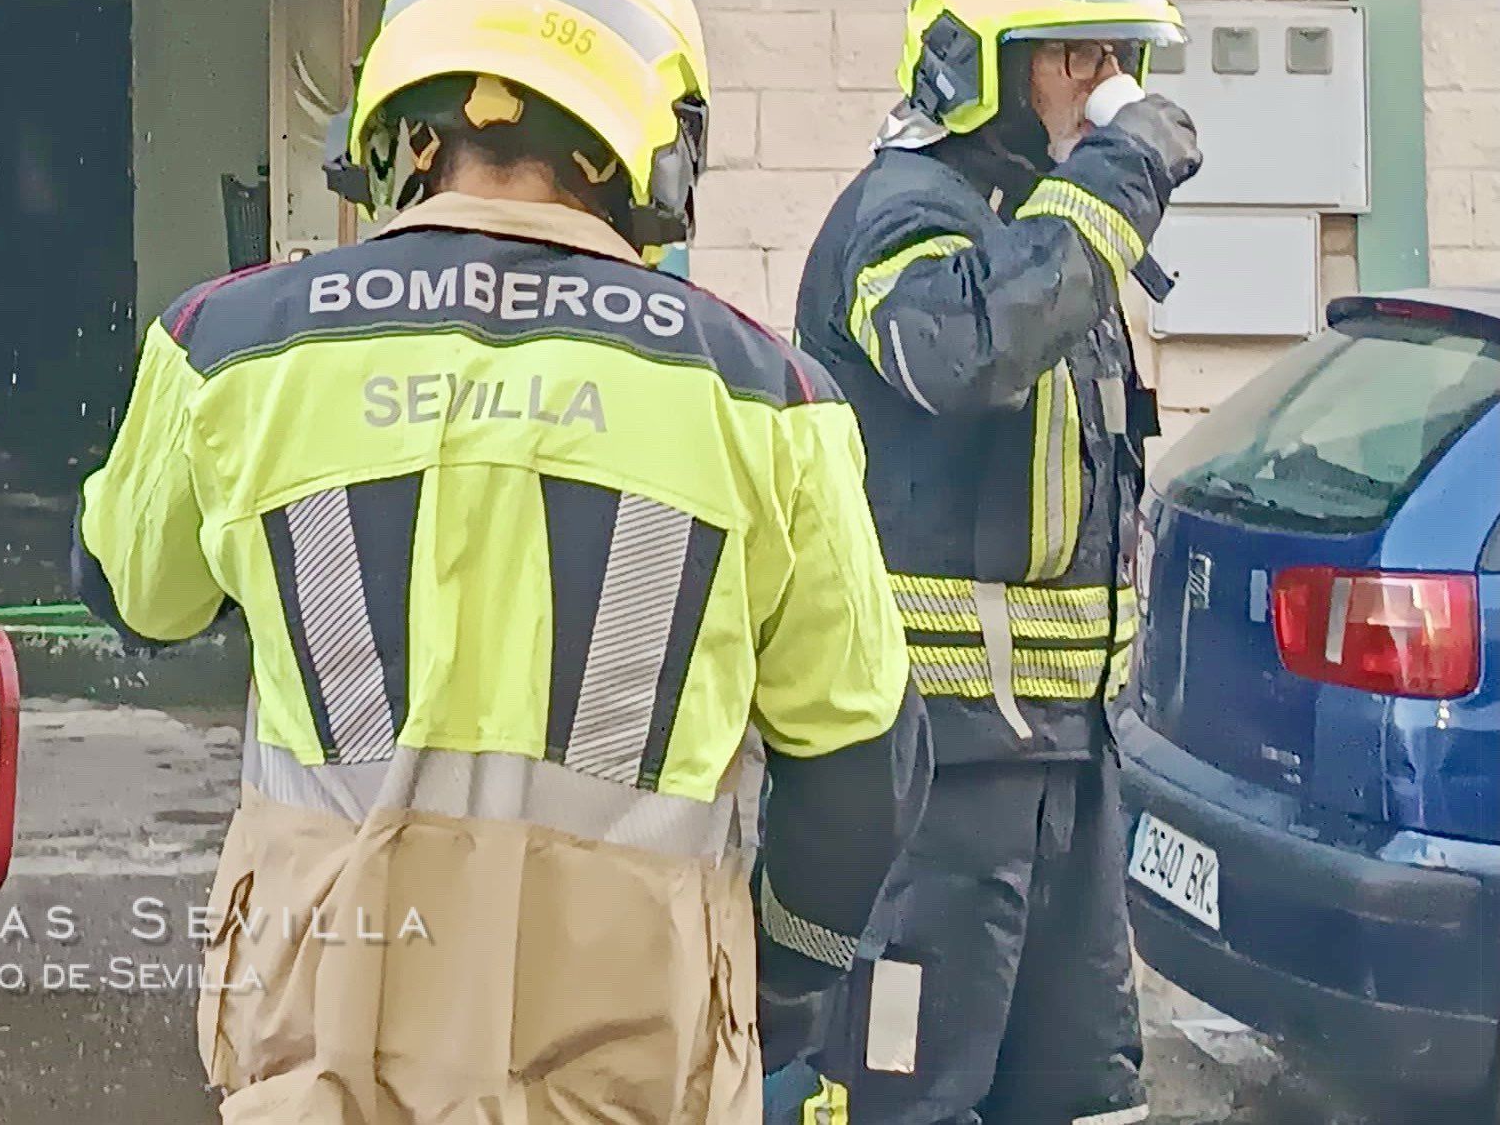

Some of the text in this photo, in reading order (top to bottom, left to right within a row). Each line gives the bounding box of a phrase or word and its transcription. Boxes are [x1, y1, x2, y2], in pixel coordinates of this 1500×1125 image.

[540, 11, 597, 55] 595
[309, 261, 686, 337] BOMBEROS
[363, 373, 608, 433] SEVILLA
